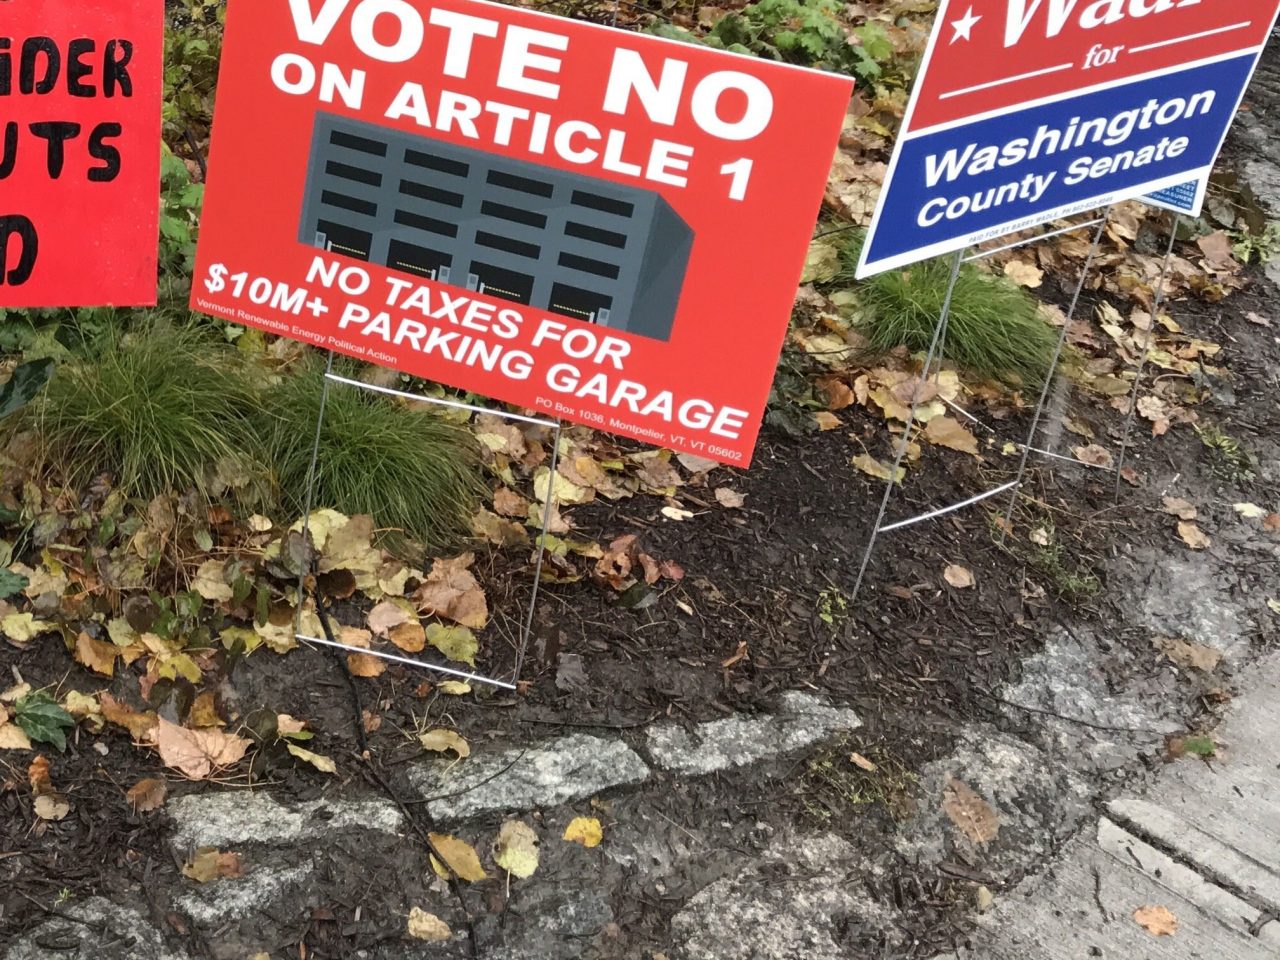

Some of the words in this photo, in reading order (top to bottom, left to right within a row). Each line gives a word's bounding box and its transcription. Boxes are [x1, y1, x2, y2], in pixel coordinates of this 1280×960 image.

[602, 46, 774, 141] NO
[1081, 42, 1124, 72] for
[270, 52, 366, 111] ON
[385, 80, 695, 188] ARTICLE
[718, 157, 753, 202] 1
[924, 87, 1217, 191] Washington
[916, 167, 1058, 228] County
[1068, 133, 1190, 183] Senate
[1011, 219, 1034, 233] BARRY
[197, 297, 235, 316] Vermont
[237, 309, 289, 332] Renewable
[292, 326, 326, 344] Energy
[328, 336, 365, 354] Political
[366, 348, 397, 364] Action
[204, 262, 329, 319] $10M+
[337, 302, 533, 382] PARKING
[545, 358, 750, 440] GARAGE
[305, 256, 371, 296] NO
[385, 275, 526, 341] TAXES
[531, 317, 631, 371] FOR
[535, 396, 553, 408] PO
[555, 402, 575, 416] Box
[579, 410, 606, 426] 1036,
[609, 418, 666, 442] Montpelier,
[670, 434, 687, 447] VT,
[690, 439, 706, 451] VT
[708, 444, 743, 461] 05602
